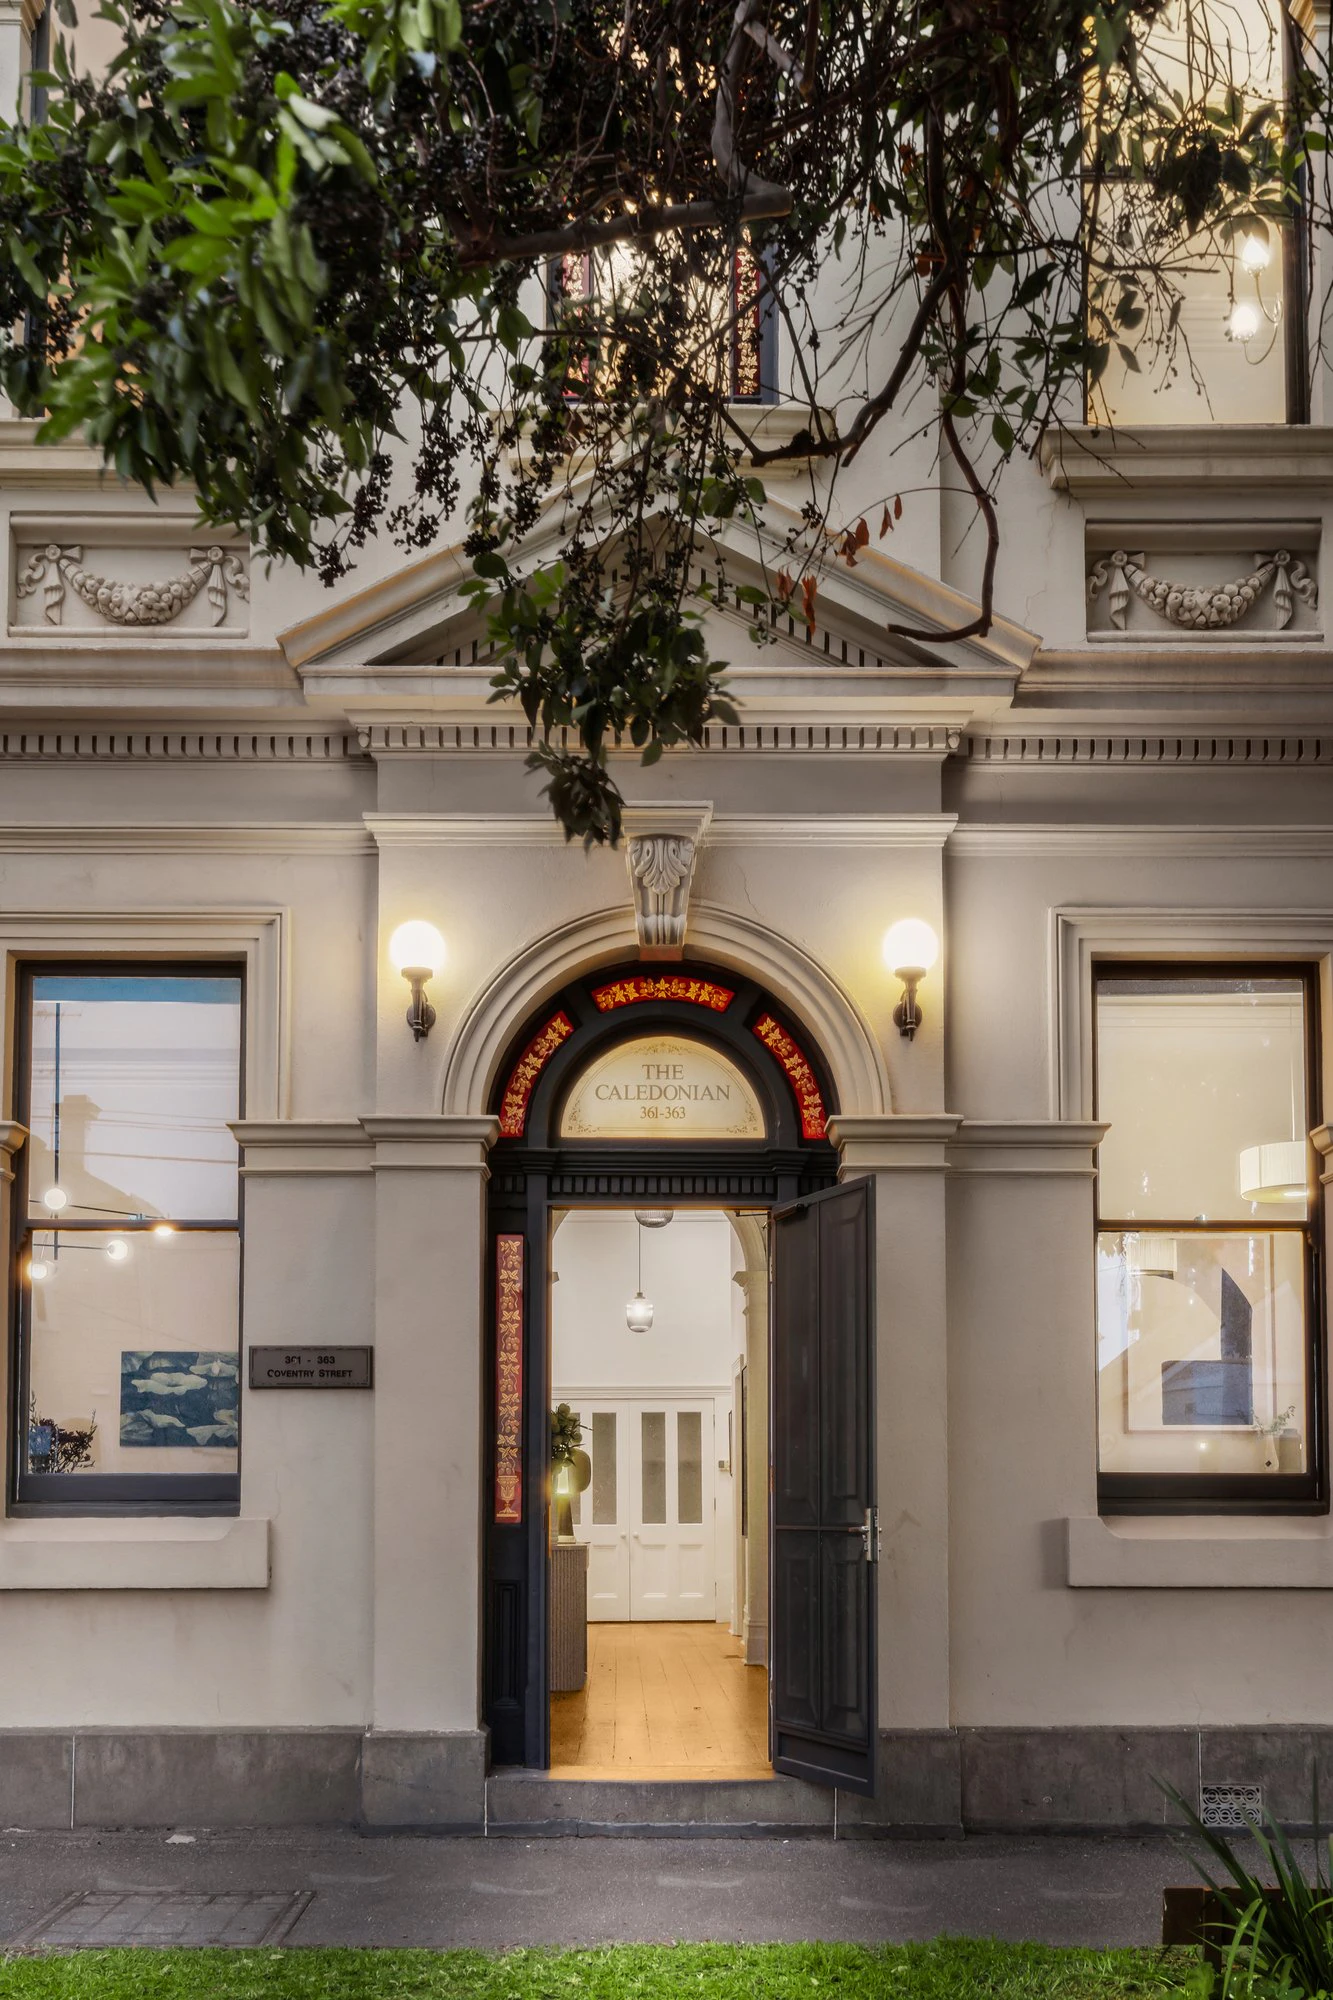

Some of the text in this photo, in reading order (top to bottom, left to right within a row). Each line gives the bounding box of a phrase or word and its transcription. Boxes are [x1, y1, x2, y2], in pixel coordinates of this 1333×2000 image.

[642, 1064, 684, 1080] THE
[595, 1085, 731, 1101] CALEDONIAN
[640, 1106, 686, 1119] 361-363
[317, 1356, 335, 1364] 363
[267, 1369, 353, 1378] COVENTRY STREET
